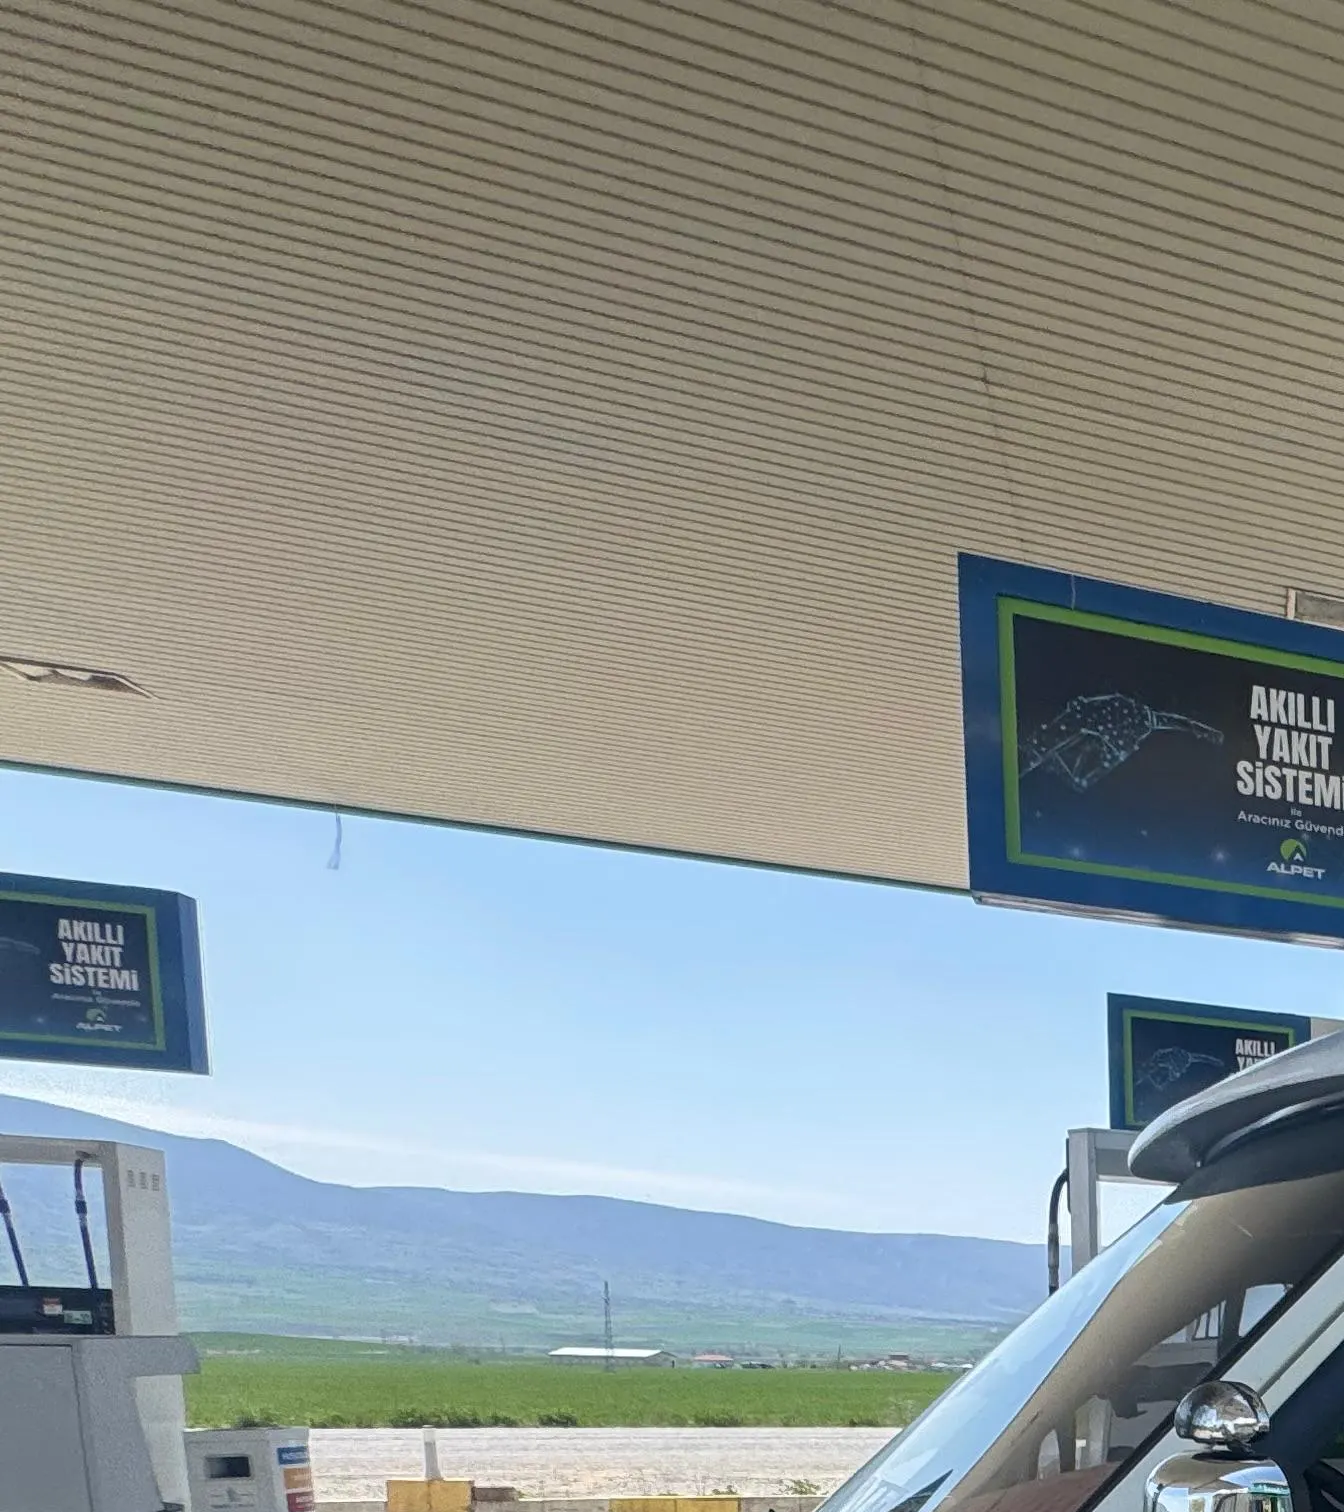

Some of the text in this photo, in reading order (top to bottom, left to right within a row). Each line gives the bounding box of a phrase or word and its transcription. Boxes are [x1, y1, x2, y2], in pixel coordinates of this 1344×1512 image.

[1250, 685, 1335, 733] AKILLI
[1254, 723, 1333, 771] YAKIT
[1237, 809, 1292, 829] Aracınız
[1266, 861, 1326, 881] ALPET
[58, 918, 124, 945] AKILLI
[60, 941, 123, 967] YAKIT
